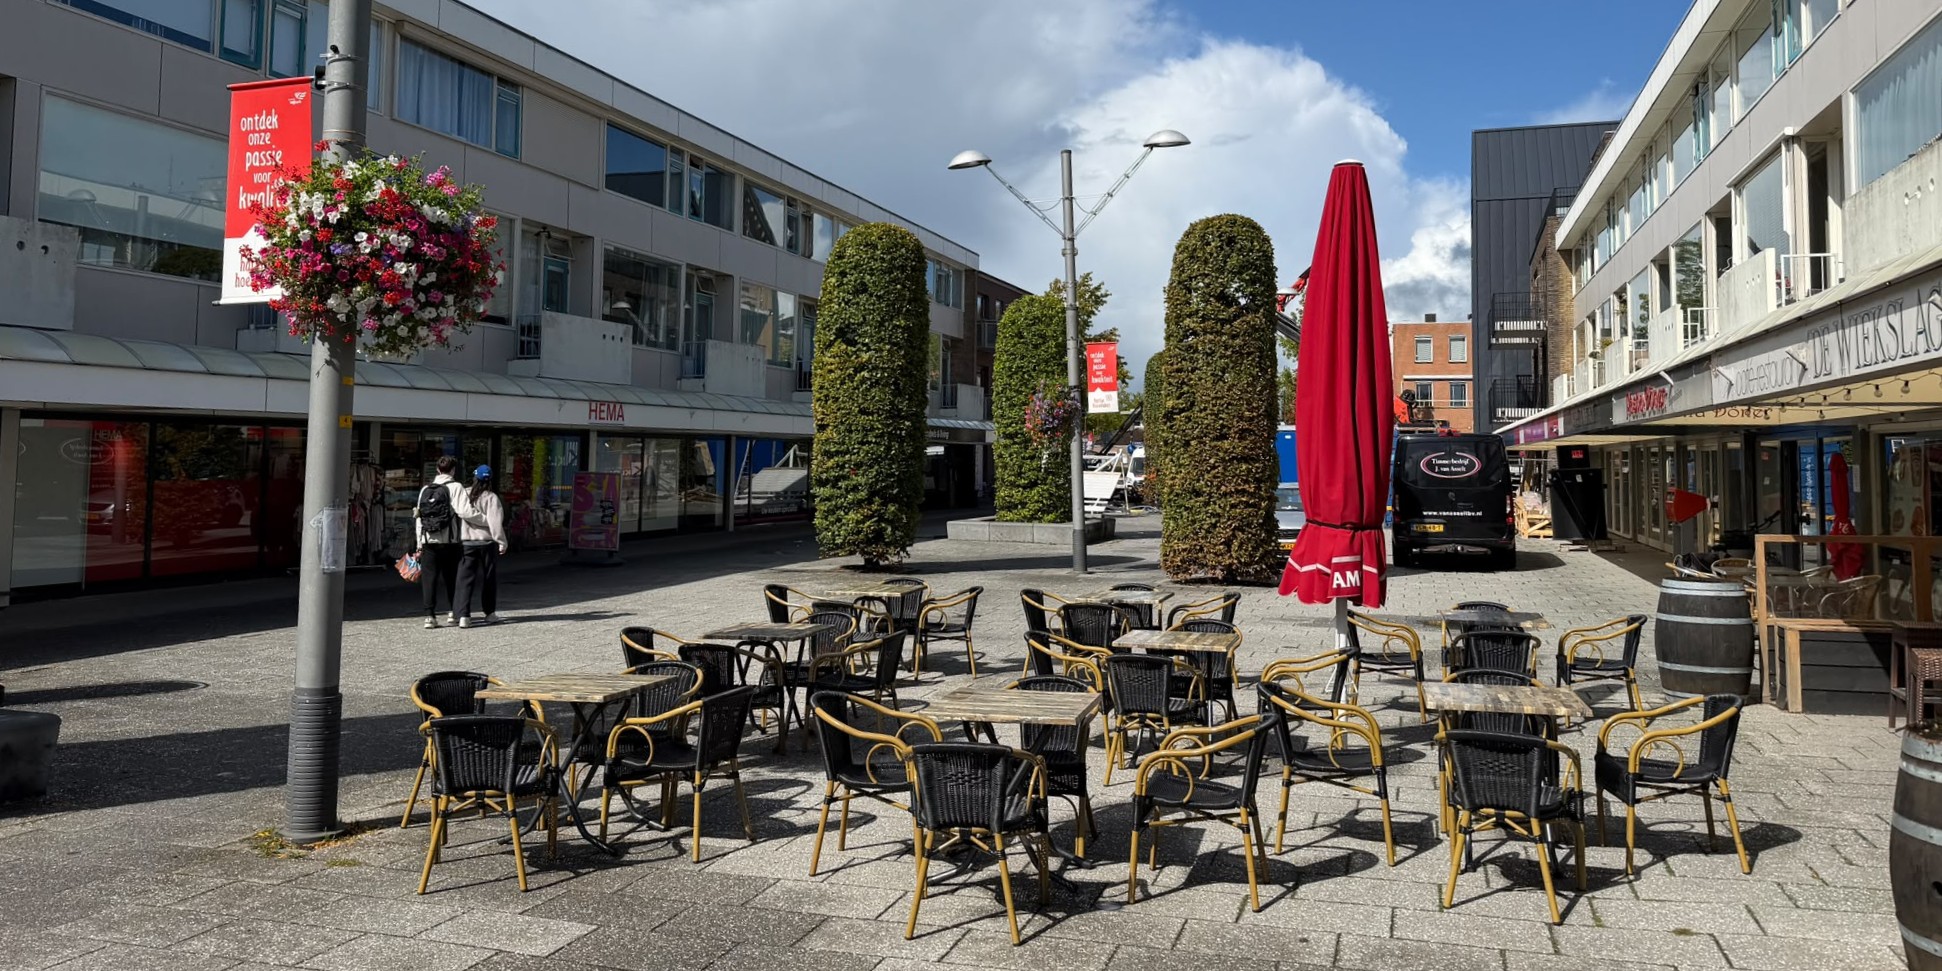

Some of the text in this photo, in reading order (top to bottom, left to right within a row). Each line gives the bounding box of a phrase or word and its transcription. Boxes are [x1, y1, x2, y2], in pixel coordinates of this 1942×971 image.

[240, 108, 278, 131] ontdek
[248, 132, 271, 146] onze
[246, 145, 283, 172] passie
[253, 172, 272, 183] voor
[588, 401, 625, 421] HEMA
[1712, 405, 1773, 419] Döner
[1332, 570, 1361, 588] AM
